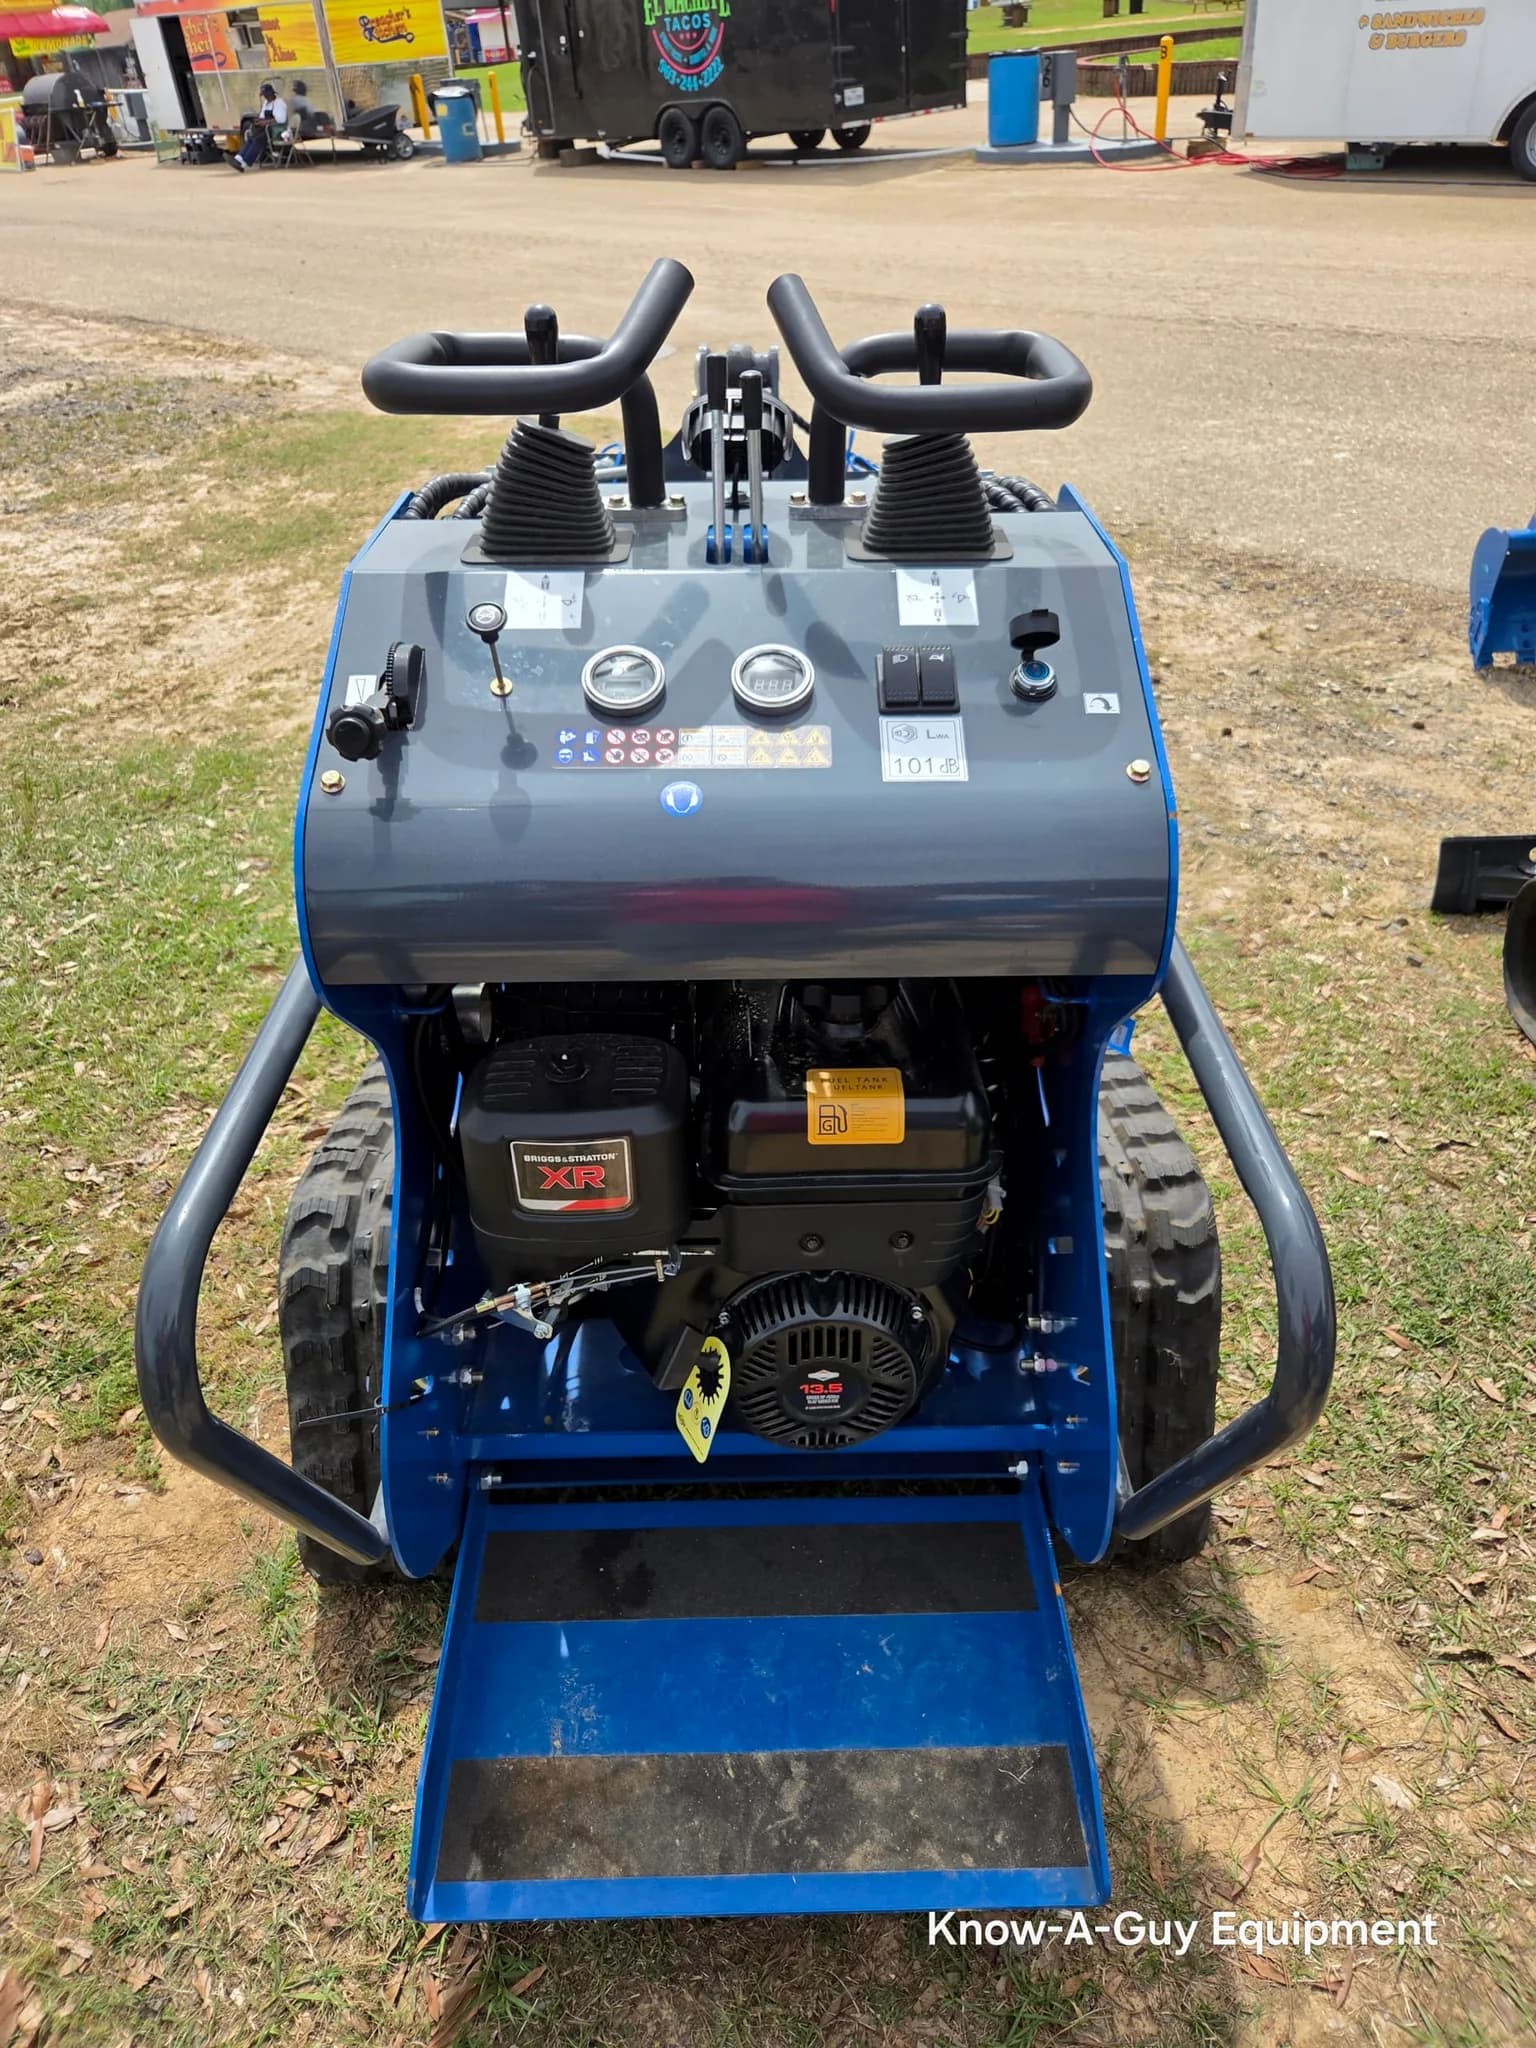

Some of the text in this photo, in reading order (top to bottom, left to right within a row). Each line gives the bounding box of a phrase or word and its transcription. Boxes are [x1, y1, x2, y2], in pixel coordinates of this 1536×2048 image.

[664, 13, 711, 32] TACOS
[894, 757, 960, 774] 101 dB
[822, 1119, 832, 1132] G
[537, 1165, 606, 1189] XR
[800, 1383, 844, 1394] 13.5
